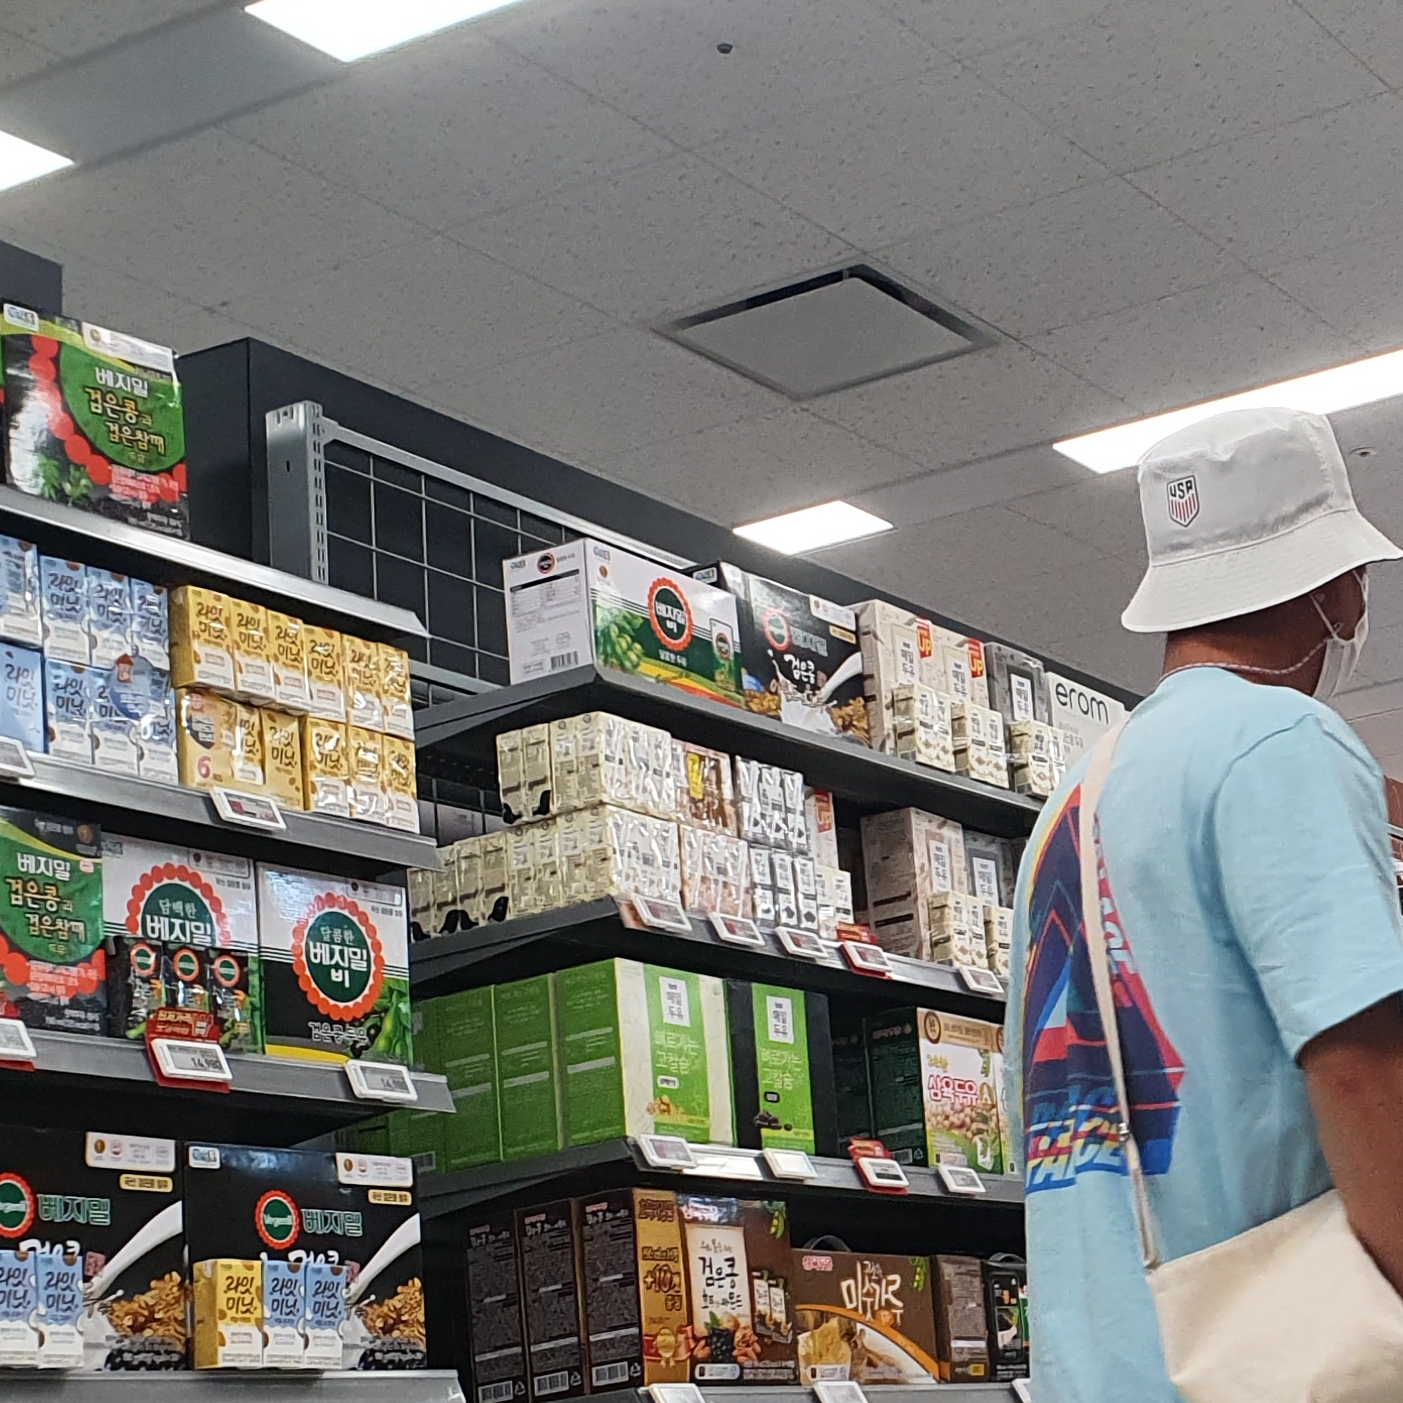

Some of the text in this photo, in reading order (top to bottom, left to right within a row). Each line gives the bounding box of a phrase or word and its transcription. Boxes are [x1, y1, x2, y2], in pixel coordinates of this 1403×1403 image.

[95, 366, 148, 398] 베지밀
[196, 602, 223, 622] 라잇
[237, 613, 261, 631] 라잇
[5, 664, 35, 689] 라잇
[311, 658, 338, 677] 미닛
[6, 687, 38, 710] 미닛
[55, 696, 87, 717] 미닛
[1055, 682, 1109, 725] erom
[271, 727, 294, 747] 라잇
[197, 756, 212, 779] 6
[272, 749, 297, 768] 미닛
[17, 852, 70, 881] 베지밀
[159, 900, 196, 919] 담백한
[25, 913, 87, 943] 검은참깨
[145, 913, 212, 947] 베지밀
[321, 926, 355, 944] 달콤한
[308, 941, 368, 972] 베지밀
[330, 969, 350, 988] 비
[927, 1074, 979, 1106] 삼육두유
[37, 1193, 111, 1226] 베지밀
[301, 1209, 363, 1237] 베지밀
[45, 1271, 76, 1292] 라잇
[698, 1256, 740, 1289] 검은콩
[224, 1275, 254, 1296] 라잇
[270, 1277, 298, 1298] 라잇
[312, 1280, 339, 1299] 라잇
[46, 1294, 79, 1312] 미닛
[226, 1297, 257, 1315] 미닛
[271, 1299, 299, 1316] 미닛
[313, 1302, 341, 1318] 미닛
